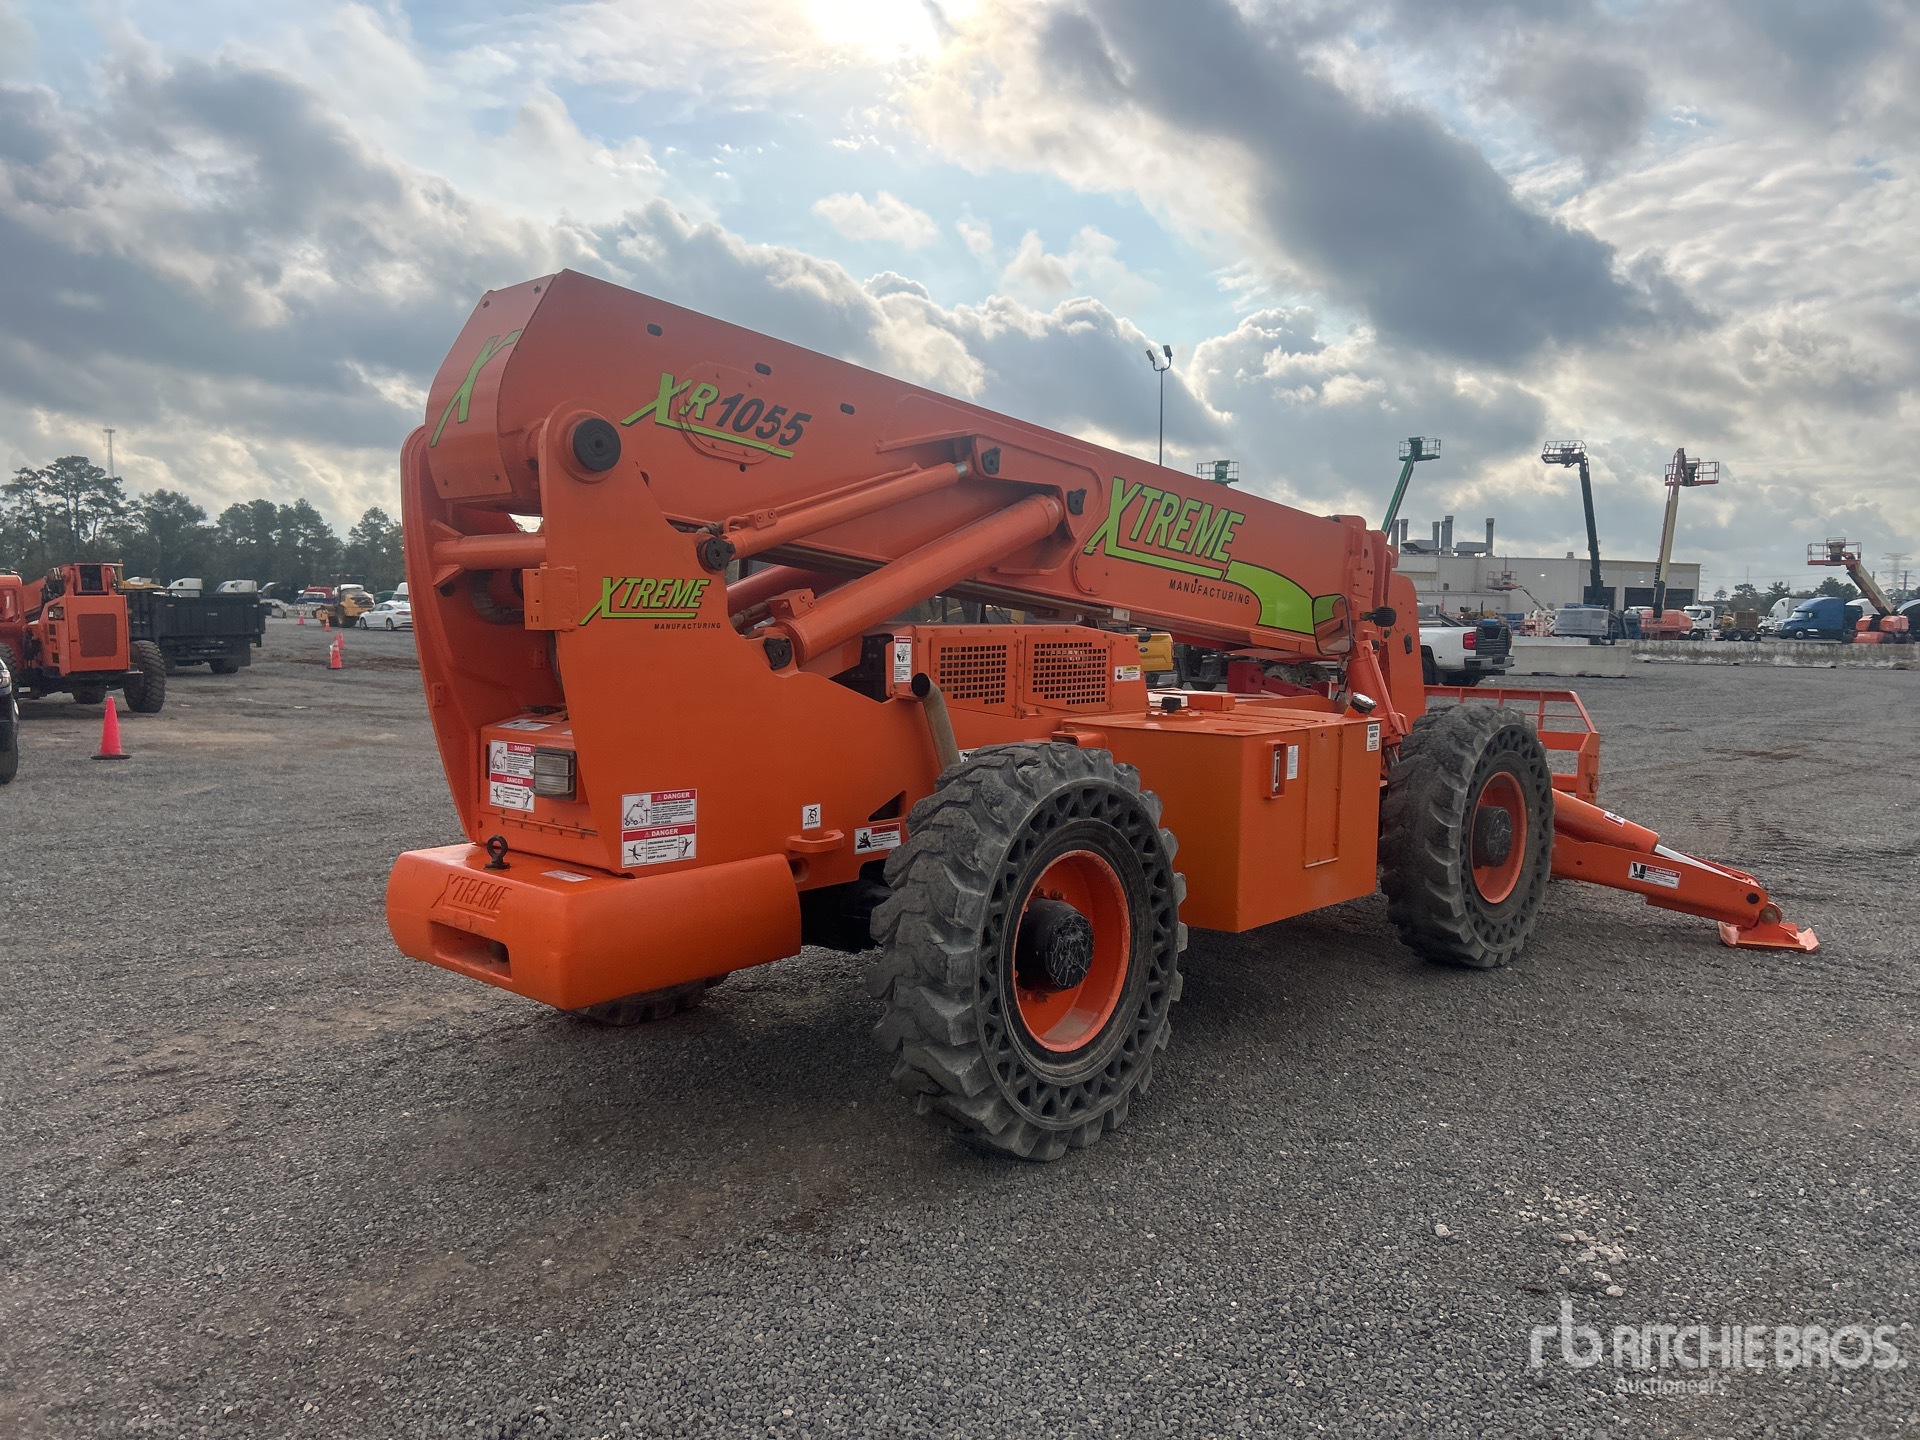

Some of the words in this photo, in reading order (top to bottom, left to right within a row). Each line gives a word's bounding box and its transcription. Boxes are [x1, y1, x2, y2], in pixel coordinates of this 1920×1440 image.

[1083, 476, 1246, 563] XTREME
[1169, 578, 1250, 605] MANUFACTURING
[579, 577, 711, 626] XTREME
[653, 622, 721, 630] MANUFACTURING
[514, 745, 532, 753] DANGER
[506, 776, 524, 785] DANGER
[663, 792, 690, 800] DANGER
[651, 828, 679, 837] DANGER
[1655, 868, 1677, 877] DANGER
[431, 873, 513, 912] XTREME
